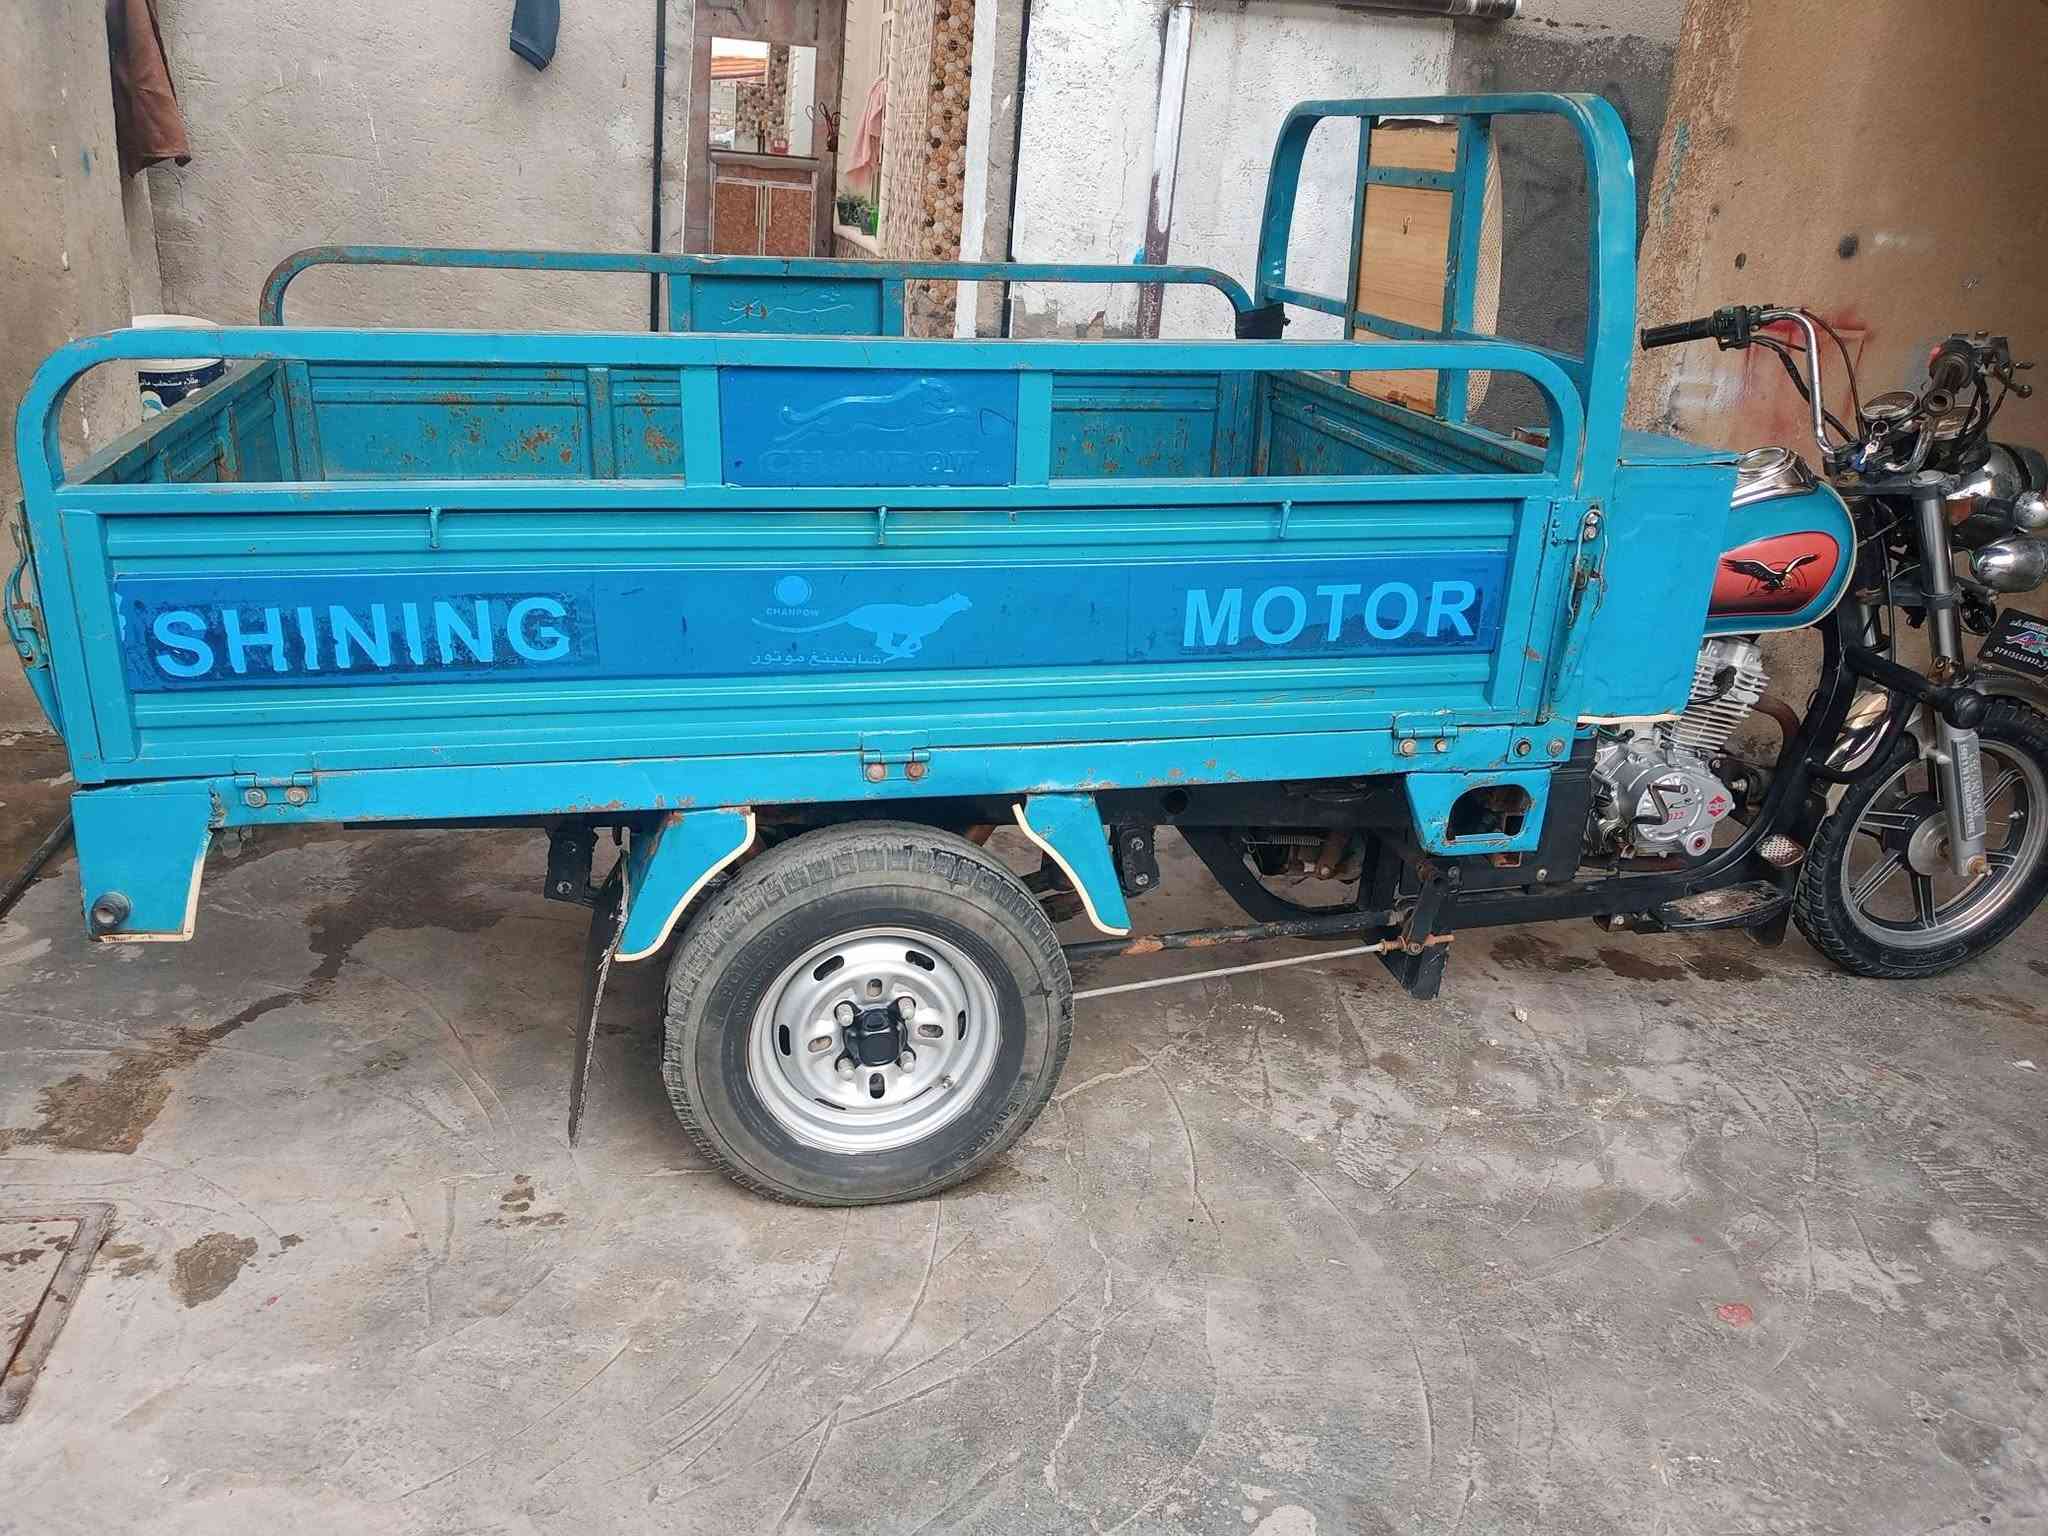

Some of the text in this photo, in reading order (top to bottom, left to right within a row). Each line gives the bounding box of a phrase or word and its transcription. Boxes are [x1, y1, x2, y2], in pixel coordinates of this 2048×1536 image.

[766, 606, 820, 617] CHANPOW
[153, 580, 1477, 678] SHINING MOTOR
[751, 650, 804, 666] موتور
